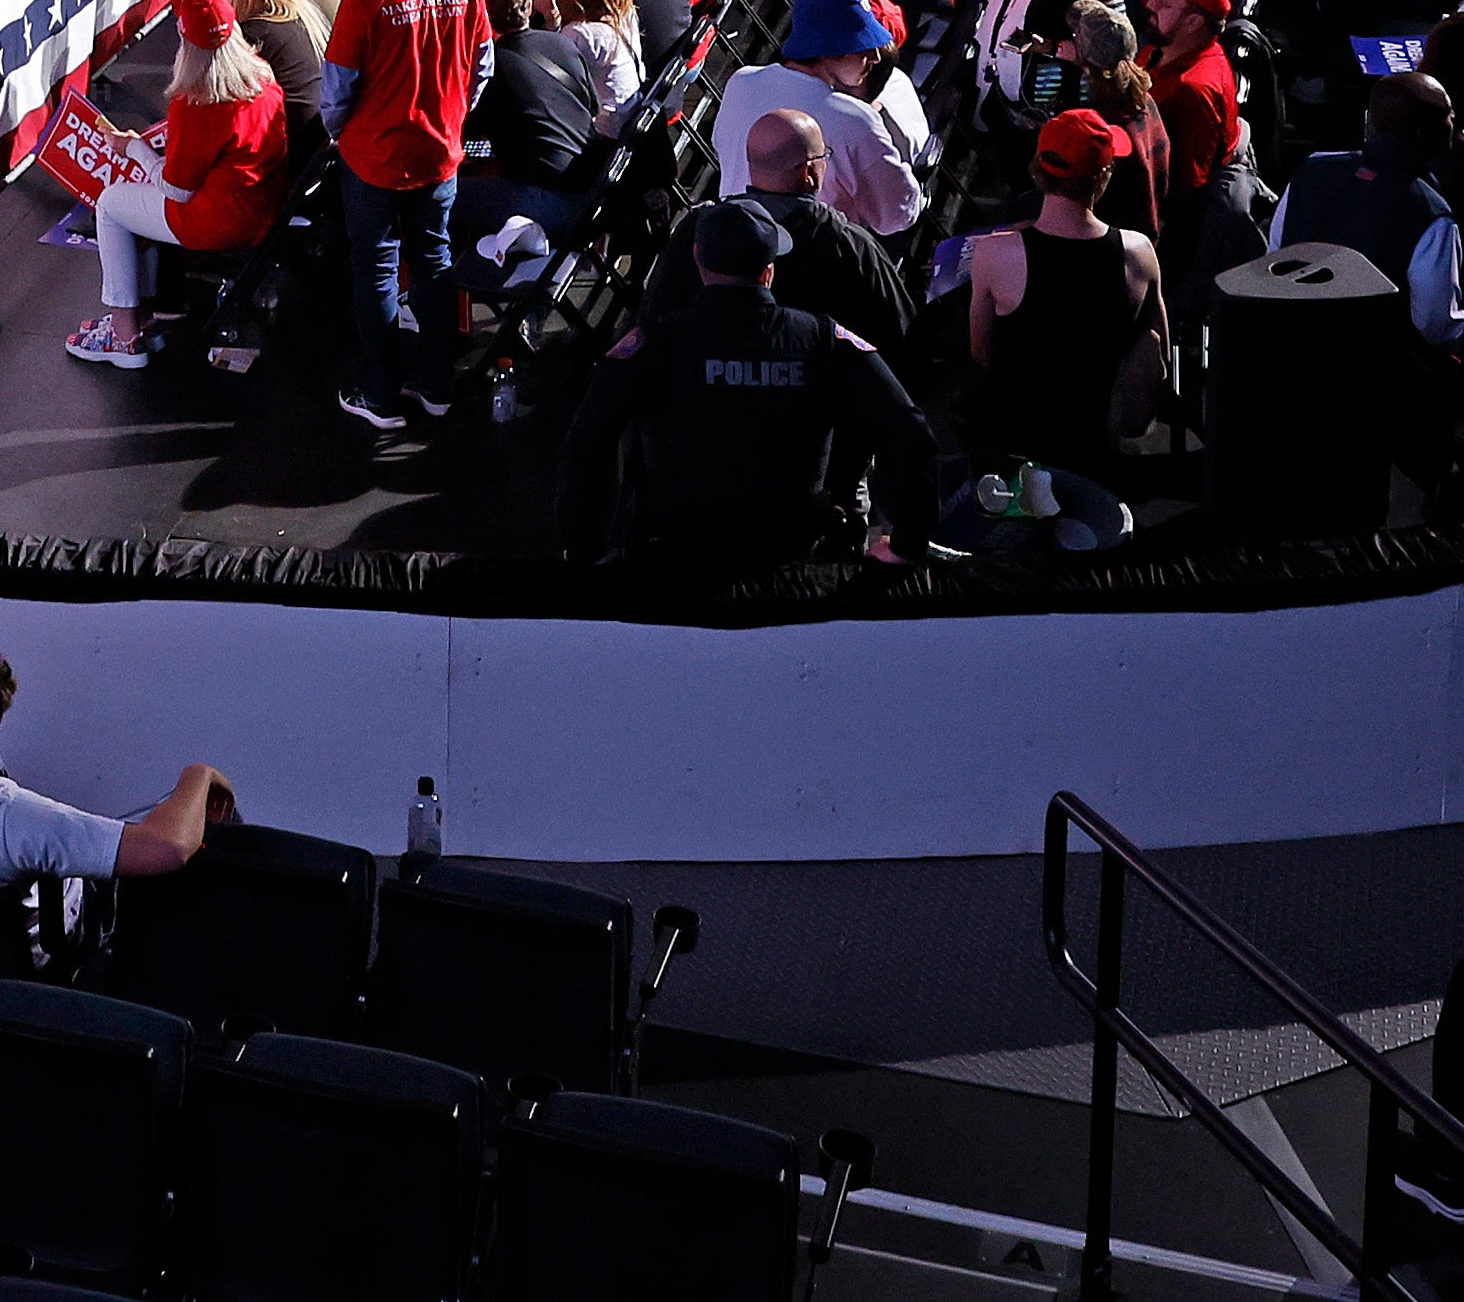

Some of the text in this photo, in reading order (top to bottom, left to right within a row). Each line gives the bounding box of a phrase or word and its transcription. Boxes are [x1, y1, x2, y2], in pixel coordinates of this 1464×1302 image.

[392, 4, 464, 26] GREAT AGAIN
[65, 112, 130, 166] DREAM
[705, 359, 805, 387] POLICE
